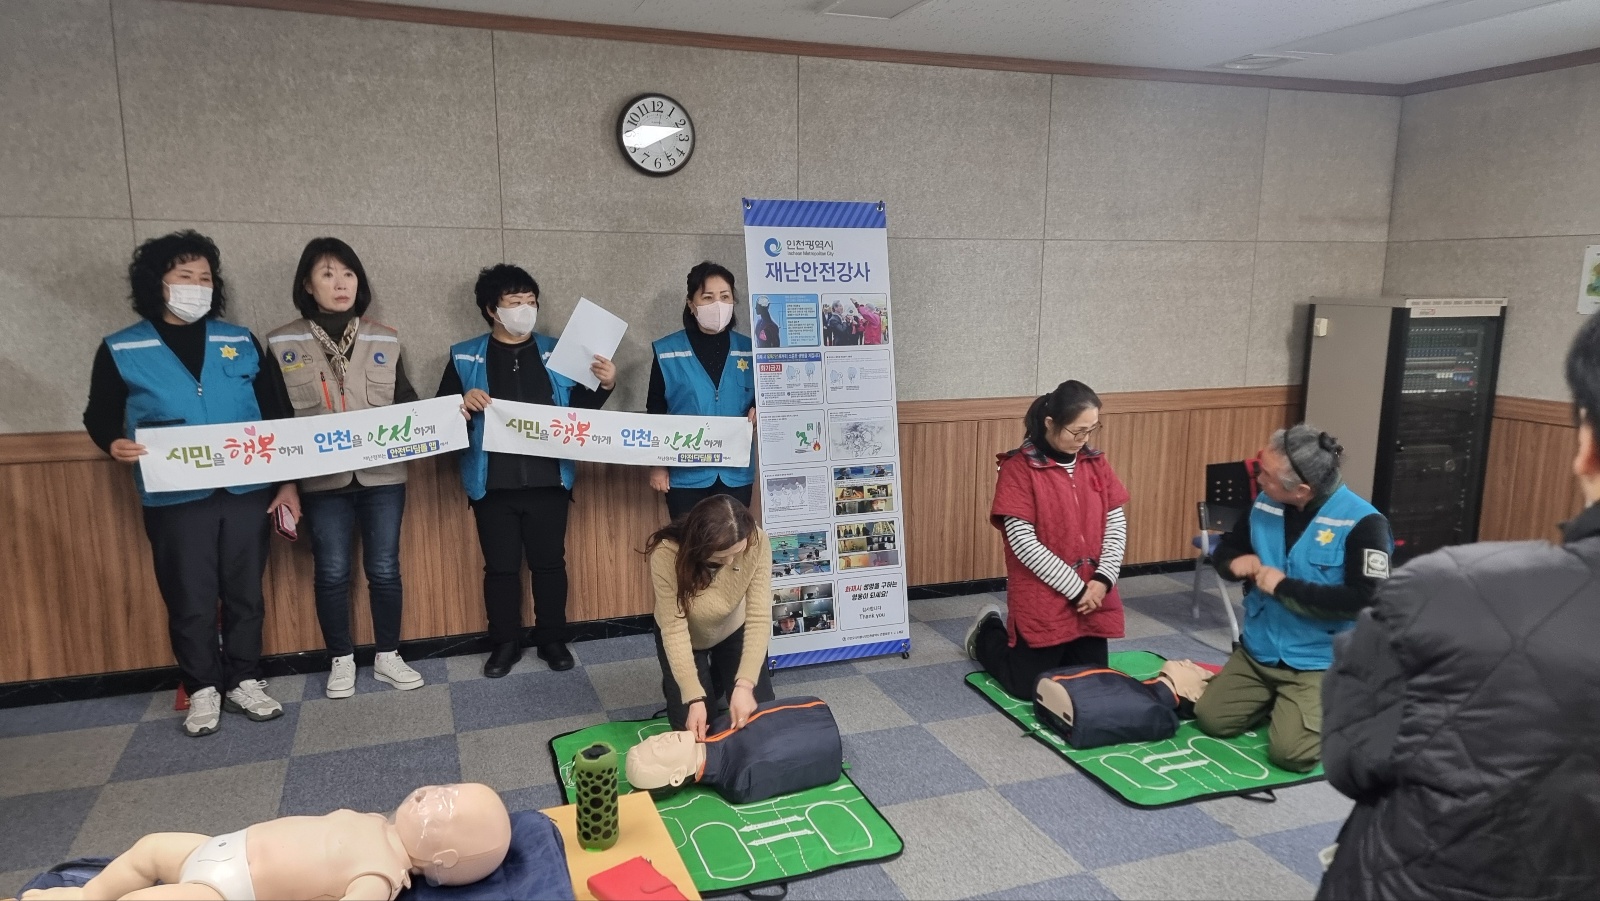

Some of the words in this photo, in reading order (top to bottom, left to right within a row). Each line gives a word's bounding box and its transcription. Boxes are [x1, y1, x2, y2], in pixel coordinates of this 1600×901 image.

[637, 104, 650, 117] 11
[651, 100, 664, 113] 12
[668, 106, 675, 117] 1
[627, 112, 640, 126] 10
[675, 119, 686, 128] 2
[641, 152, 650, 163] 7
[676, 148, 685, 157] 4
[654, 158, 662, 169] 6
[666, 153, 676, 166] 5
[786, 240, 833, 250] 인천광역시
[765, 262, 870, 282] 재난안전강사
[506, 418, 549, 441] 시민을
[550, 419, 611, 447] 행복하게
[621, 428, 660, 448] 인천을
[664, 428, 722, 451] 안전하게
[166, 445, 226, 468] 시민을
[222, 432, 304, 465] 행복하게
[314, 429, 362, 453] 인천을
[367, 415, 436, 446] 안전하게
[390, 442, 428, 458] 안전디딤돌
[429, 441, 437, 450] 앱
